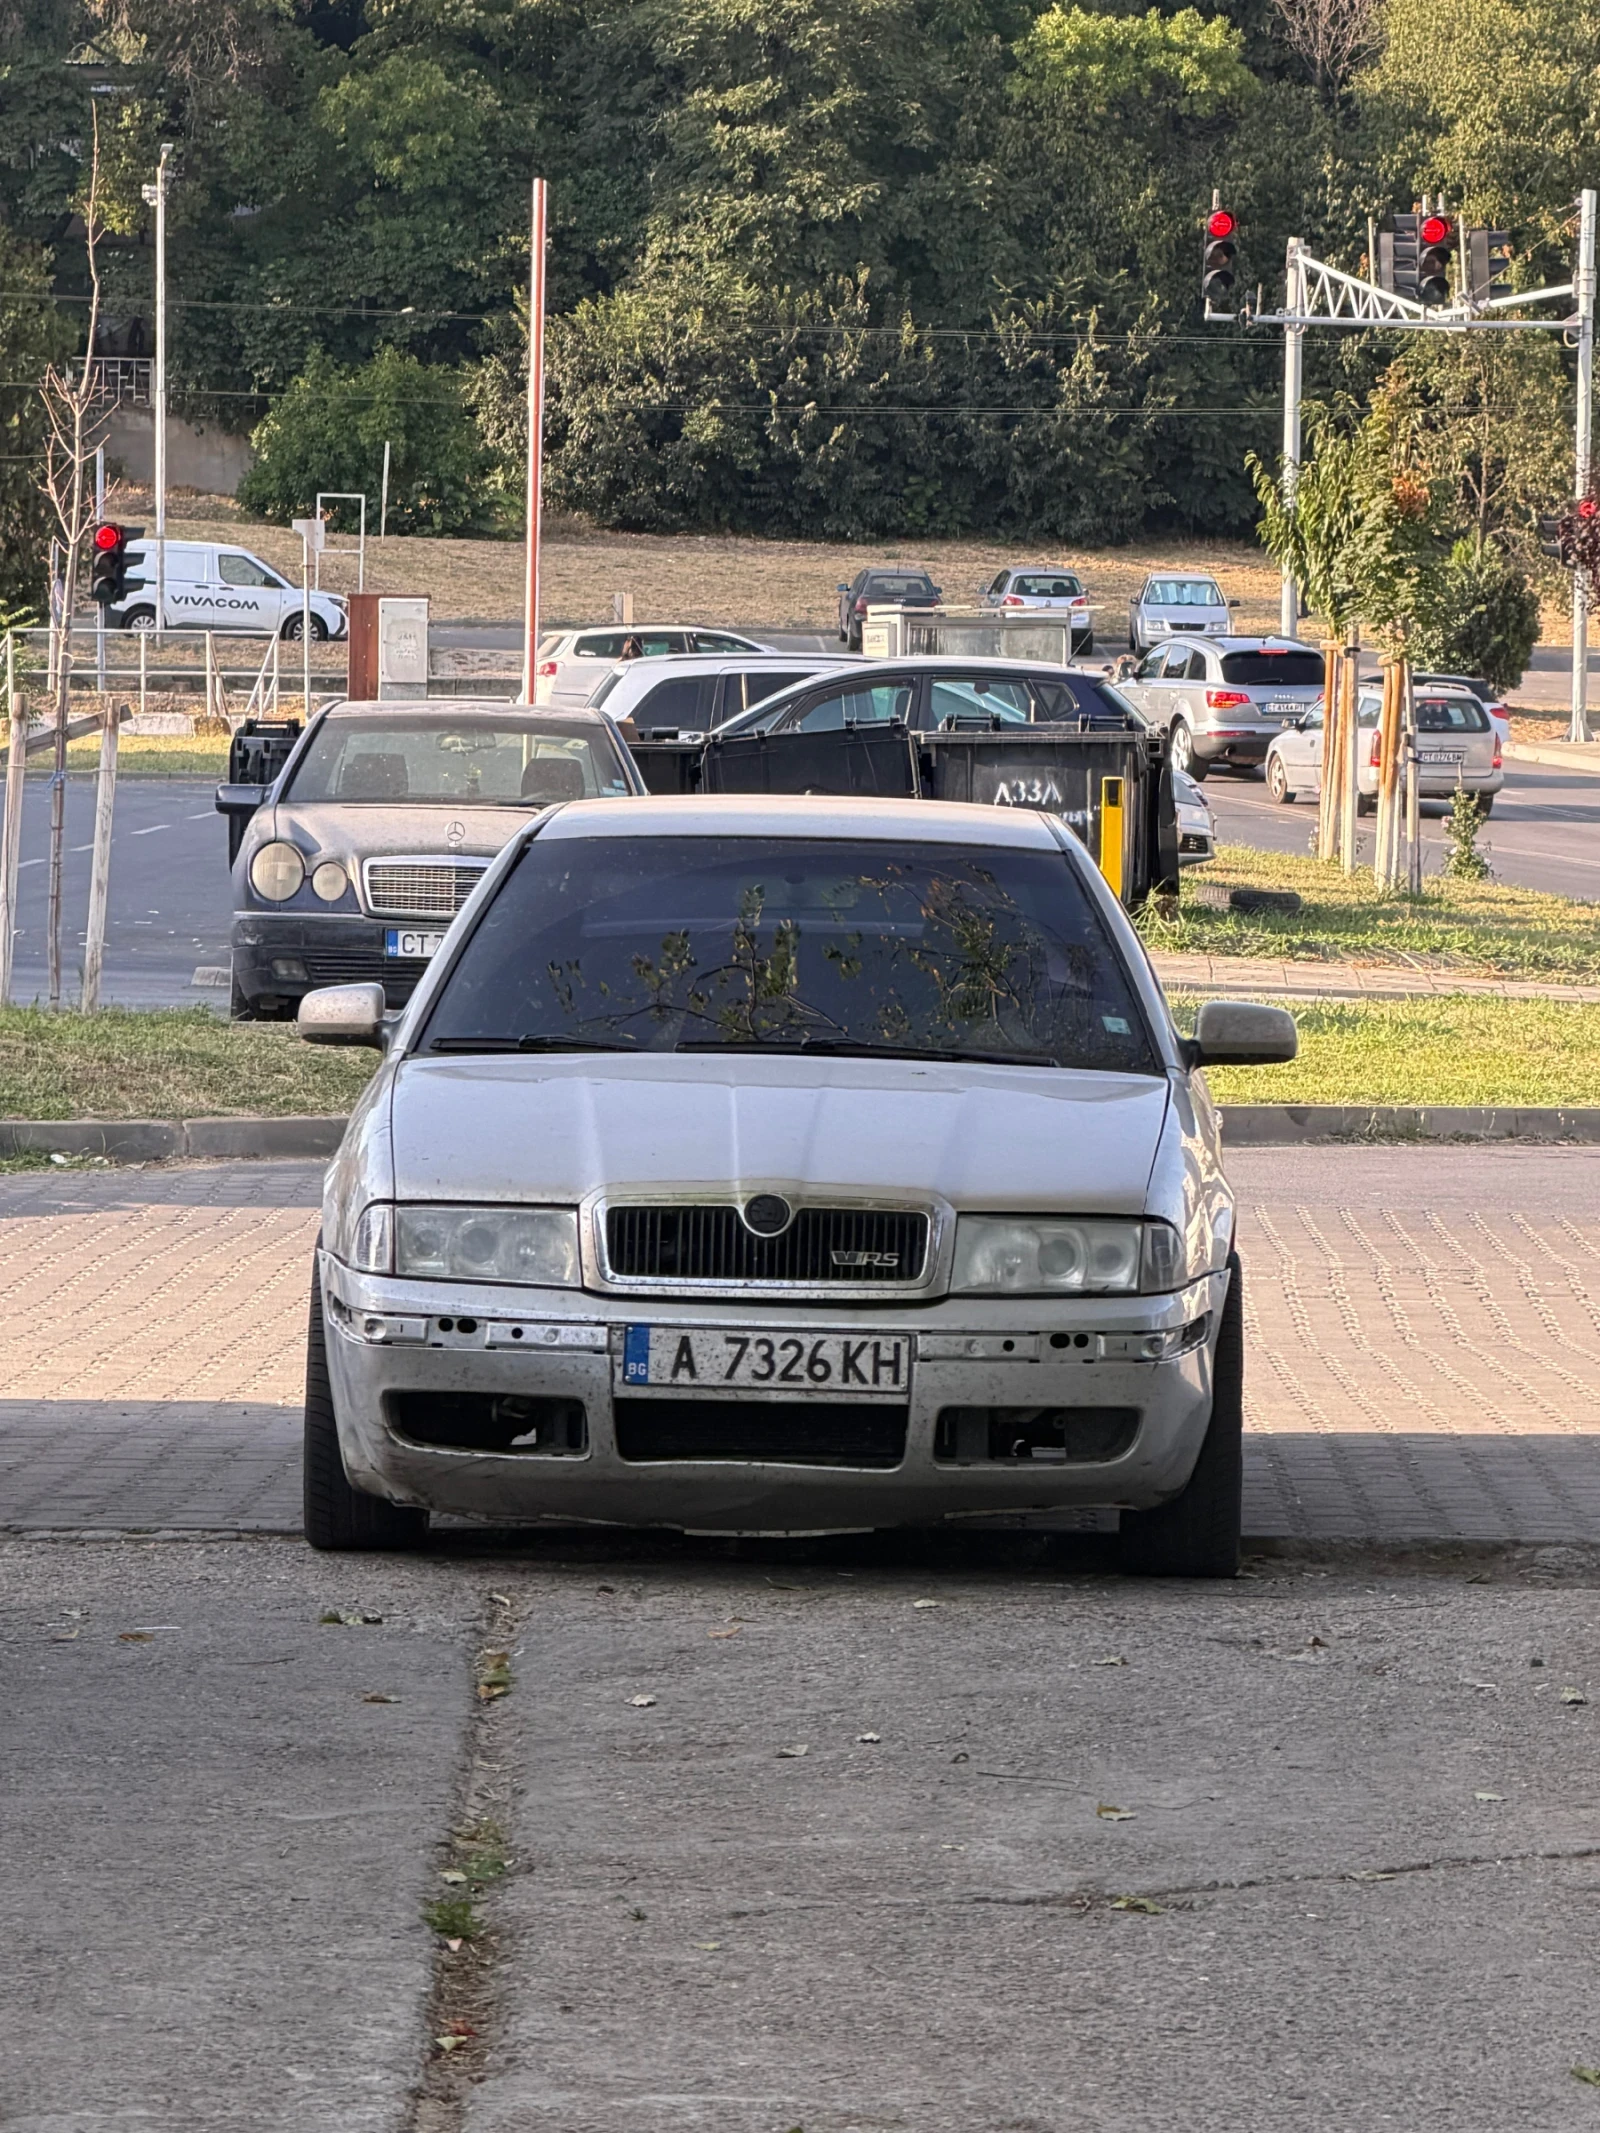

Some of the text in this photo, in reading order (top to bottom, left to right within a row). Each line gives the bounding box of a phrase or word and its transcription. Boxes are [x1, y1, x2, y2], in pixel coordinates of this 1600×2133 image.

[170, 595, 260, 611] VIVACOM
[402, 934, 429, 954] CT
[627, 1363, 647, 1377] BG
[670, 1335, 698, 1380] A
